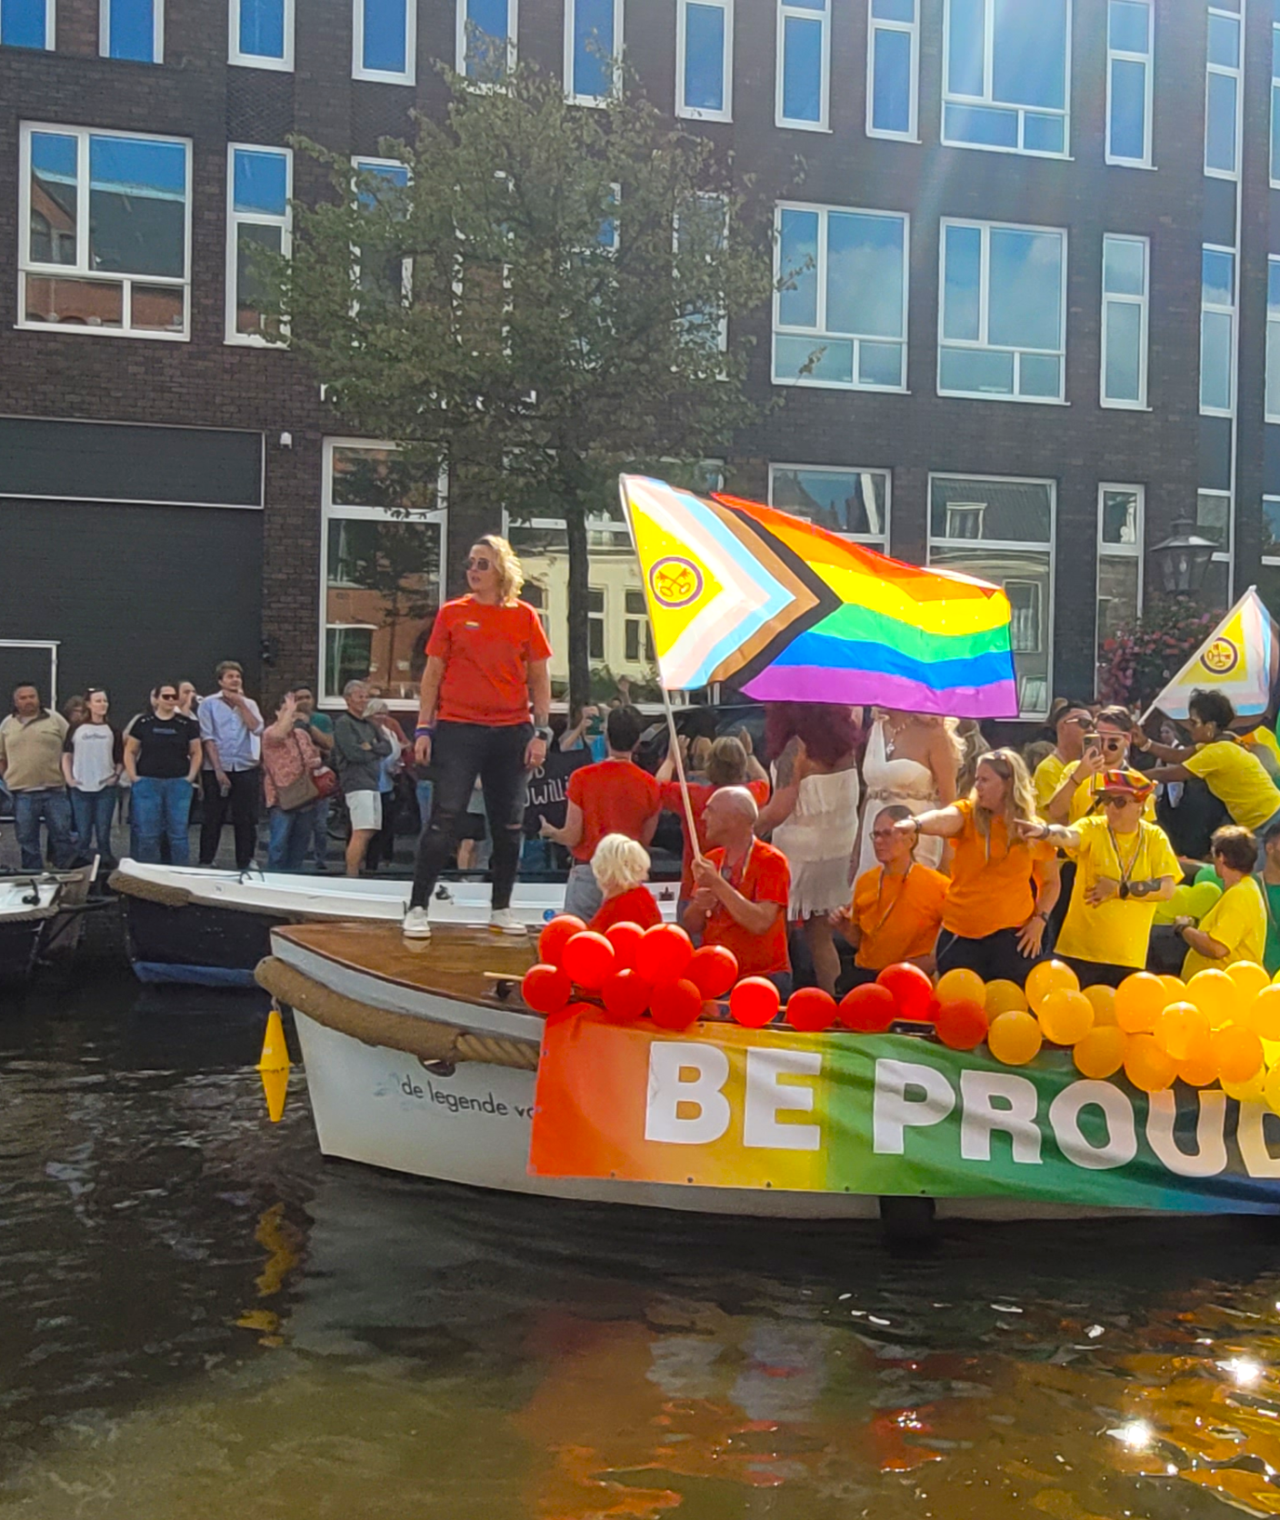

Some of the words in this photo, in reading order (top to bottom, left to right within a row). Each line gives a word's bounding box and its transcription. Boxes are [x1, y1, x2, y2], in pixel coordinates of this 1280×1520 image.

[401, 1074, 424, 1099] de
[427, 1080, 509, 1116] legende
[644, 1041, 822, 1151] BE
